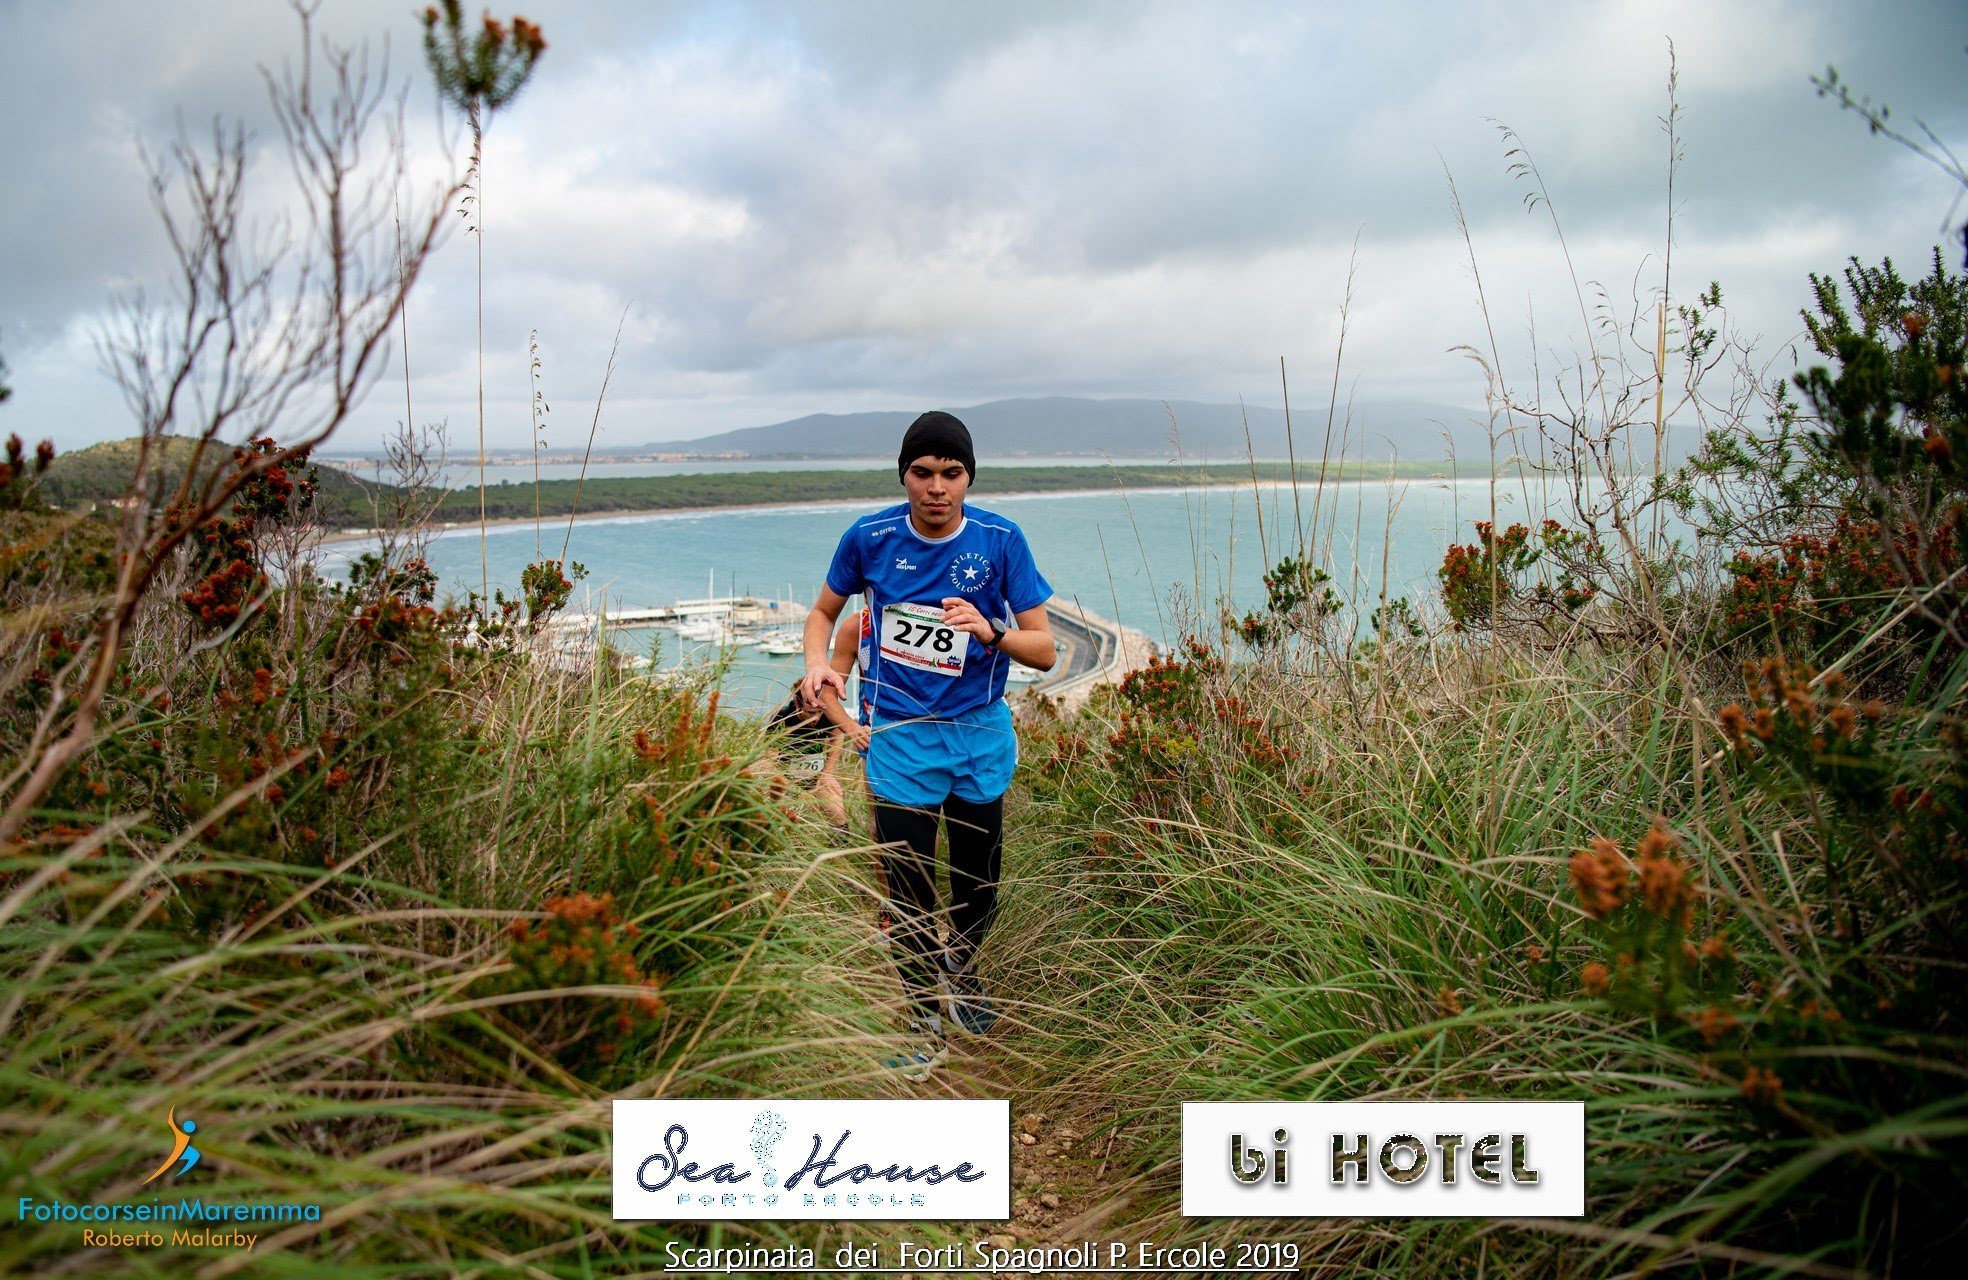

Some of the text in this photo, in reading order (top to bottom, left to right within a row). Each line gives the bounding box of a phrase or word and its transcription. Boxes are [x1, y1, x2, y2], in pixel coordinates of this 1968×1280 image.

[951, 552, 991, 572] ATLETICA
[950, 573, 991, 593] FOLLONICA
[893, 619, 955, 653] 278
